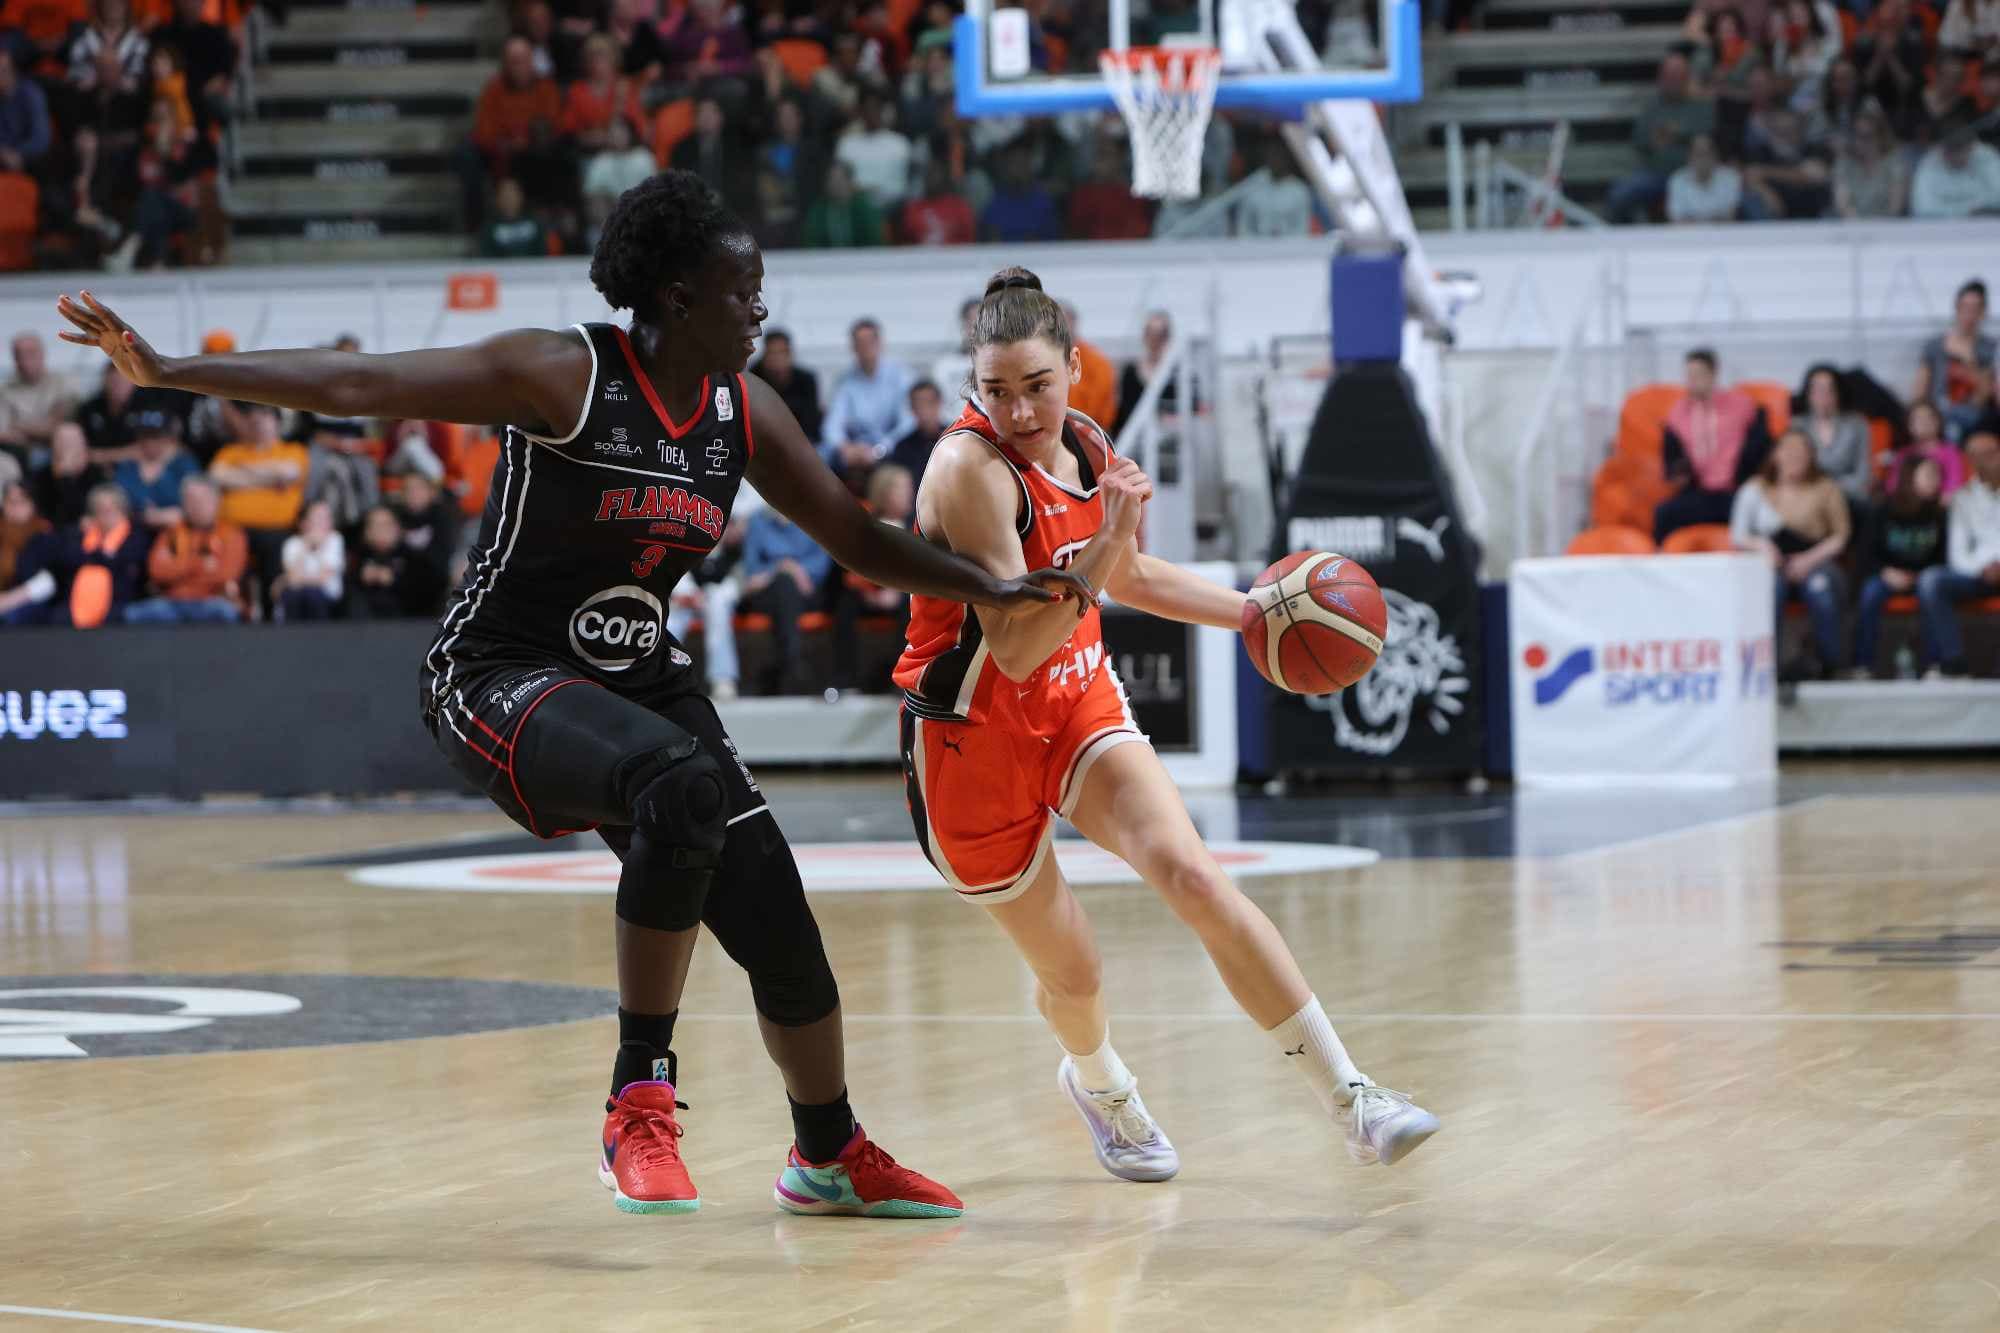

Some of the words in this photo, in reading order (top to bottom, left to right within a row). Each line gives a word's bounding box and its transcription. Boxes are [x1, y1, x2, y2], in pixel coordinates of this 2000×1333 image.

[594, 442, 643, 455] SOVELA
[595, 486, 724, 540] FLAMMES
[577, 610, 658, 649] cora
[1603, 639, 1720, 670] INTER
[1603, 671, 1718, 704] SPORT
[0, 689, 129, 739] uez
